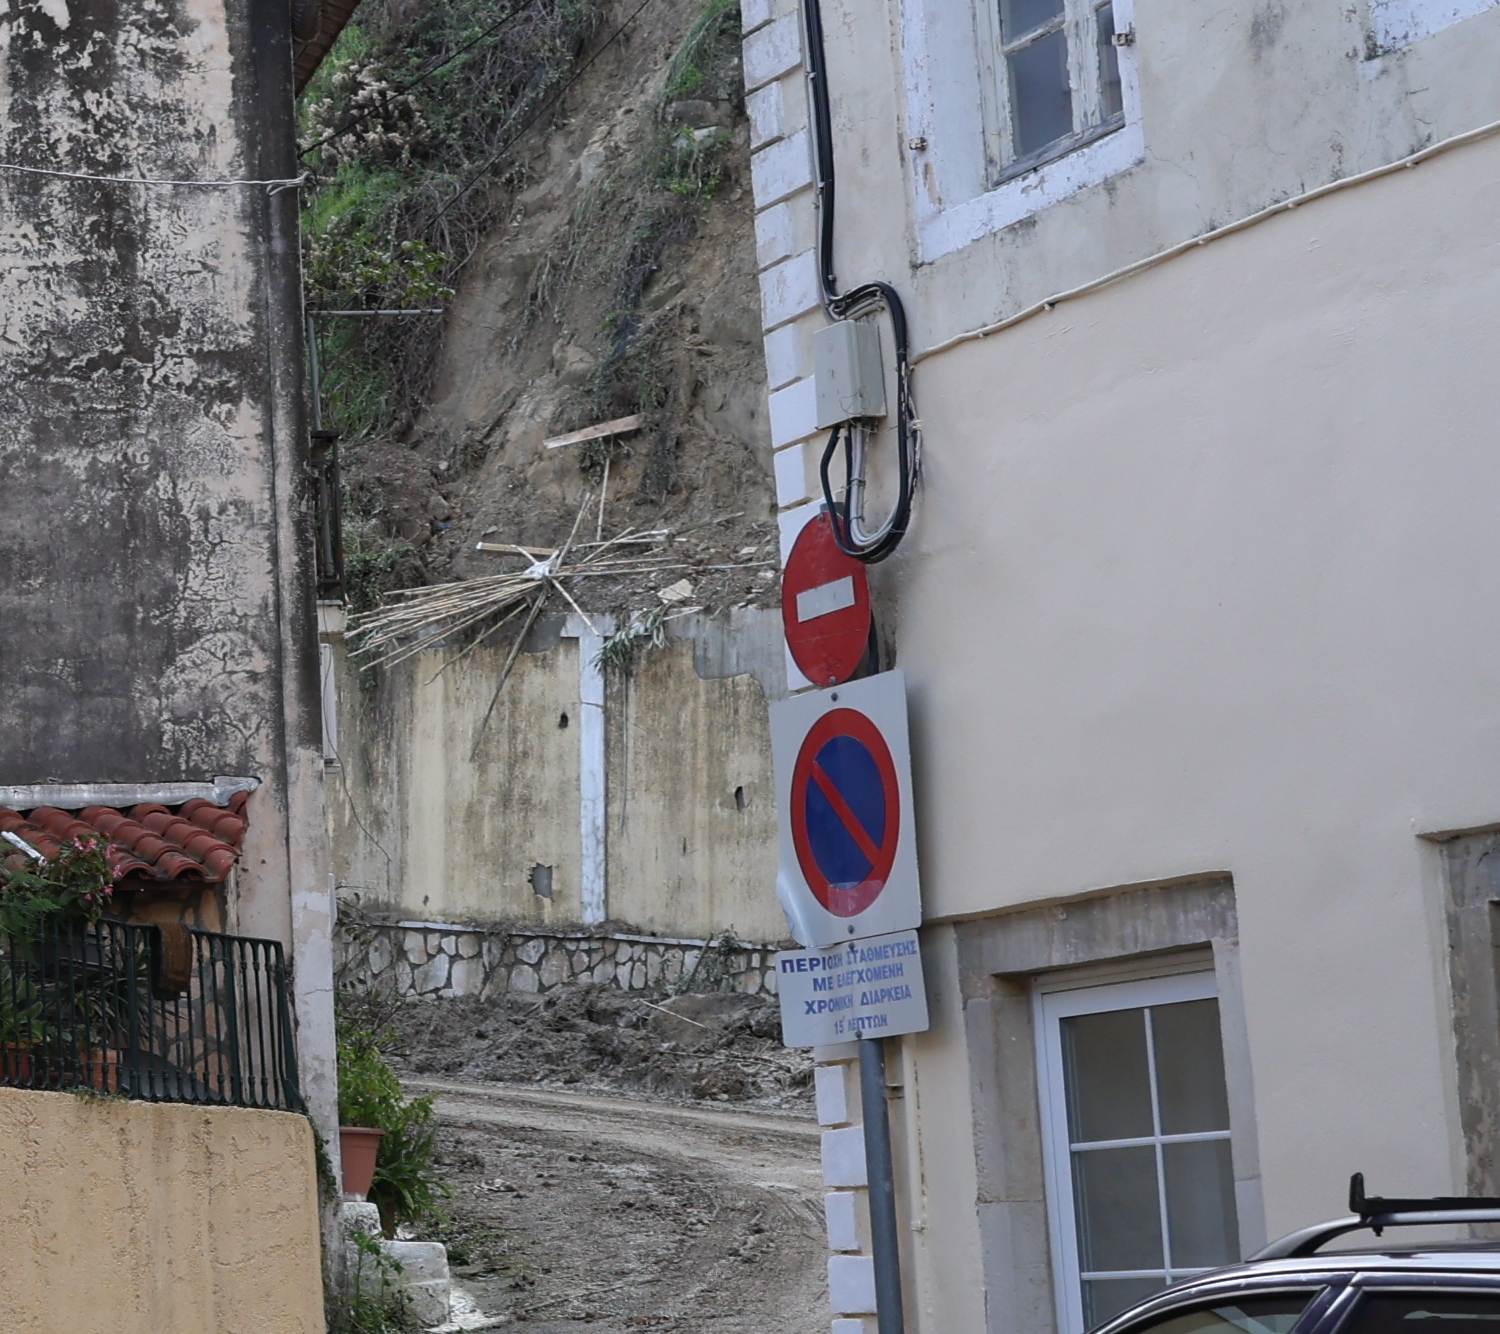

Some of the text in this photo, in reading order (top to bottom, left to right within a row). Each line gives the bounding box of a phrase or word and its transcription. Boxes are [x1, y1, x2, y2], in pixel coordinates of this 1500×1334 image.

[781, 940, 918, 974] ΠΕΡΙΟΧΗ ΣΤΑΘΜΕΥΣΗΣ
[812, 962, 904, 992] ΜΕ ΕΛΕΓΧΟΜΕΝΗ
[803, 984, 912, 1016] ΧΡΟΝΙΚΗ ΔΙΑΡΚΕΙΑ
[847, 1013, 888, 1032] ΛΕΠΤΩΝ
